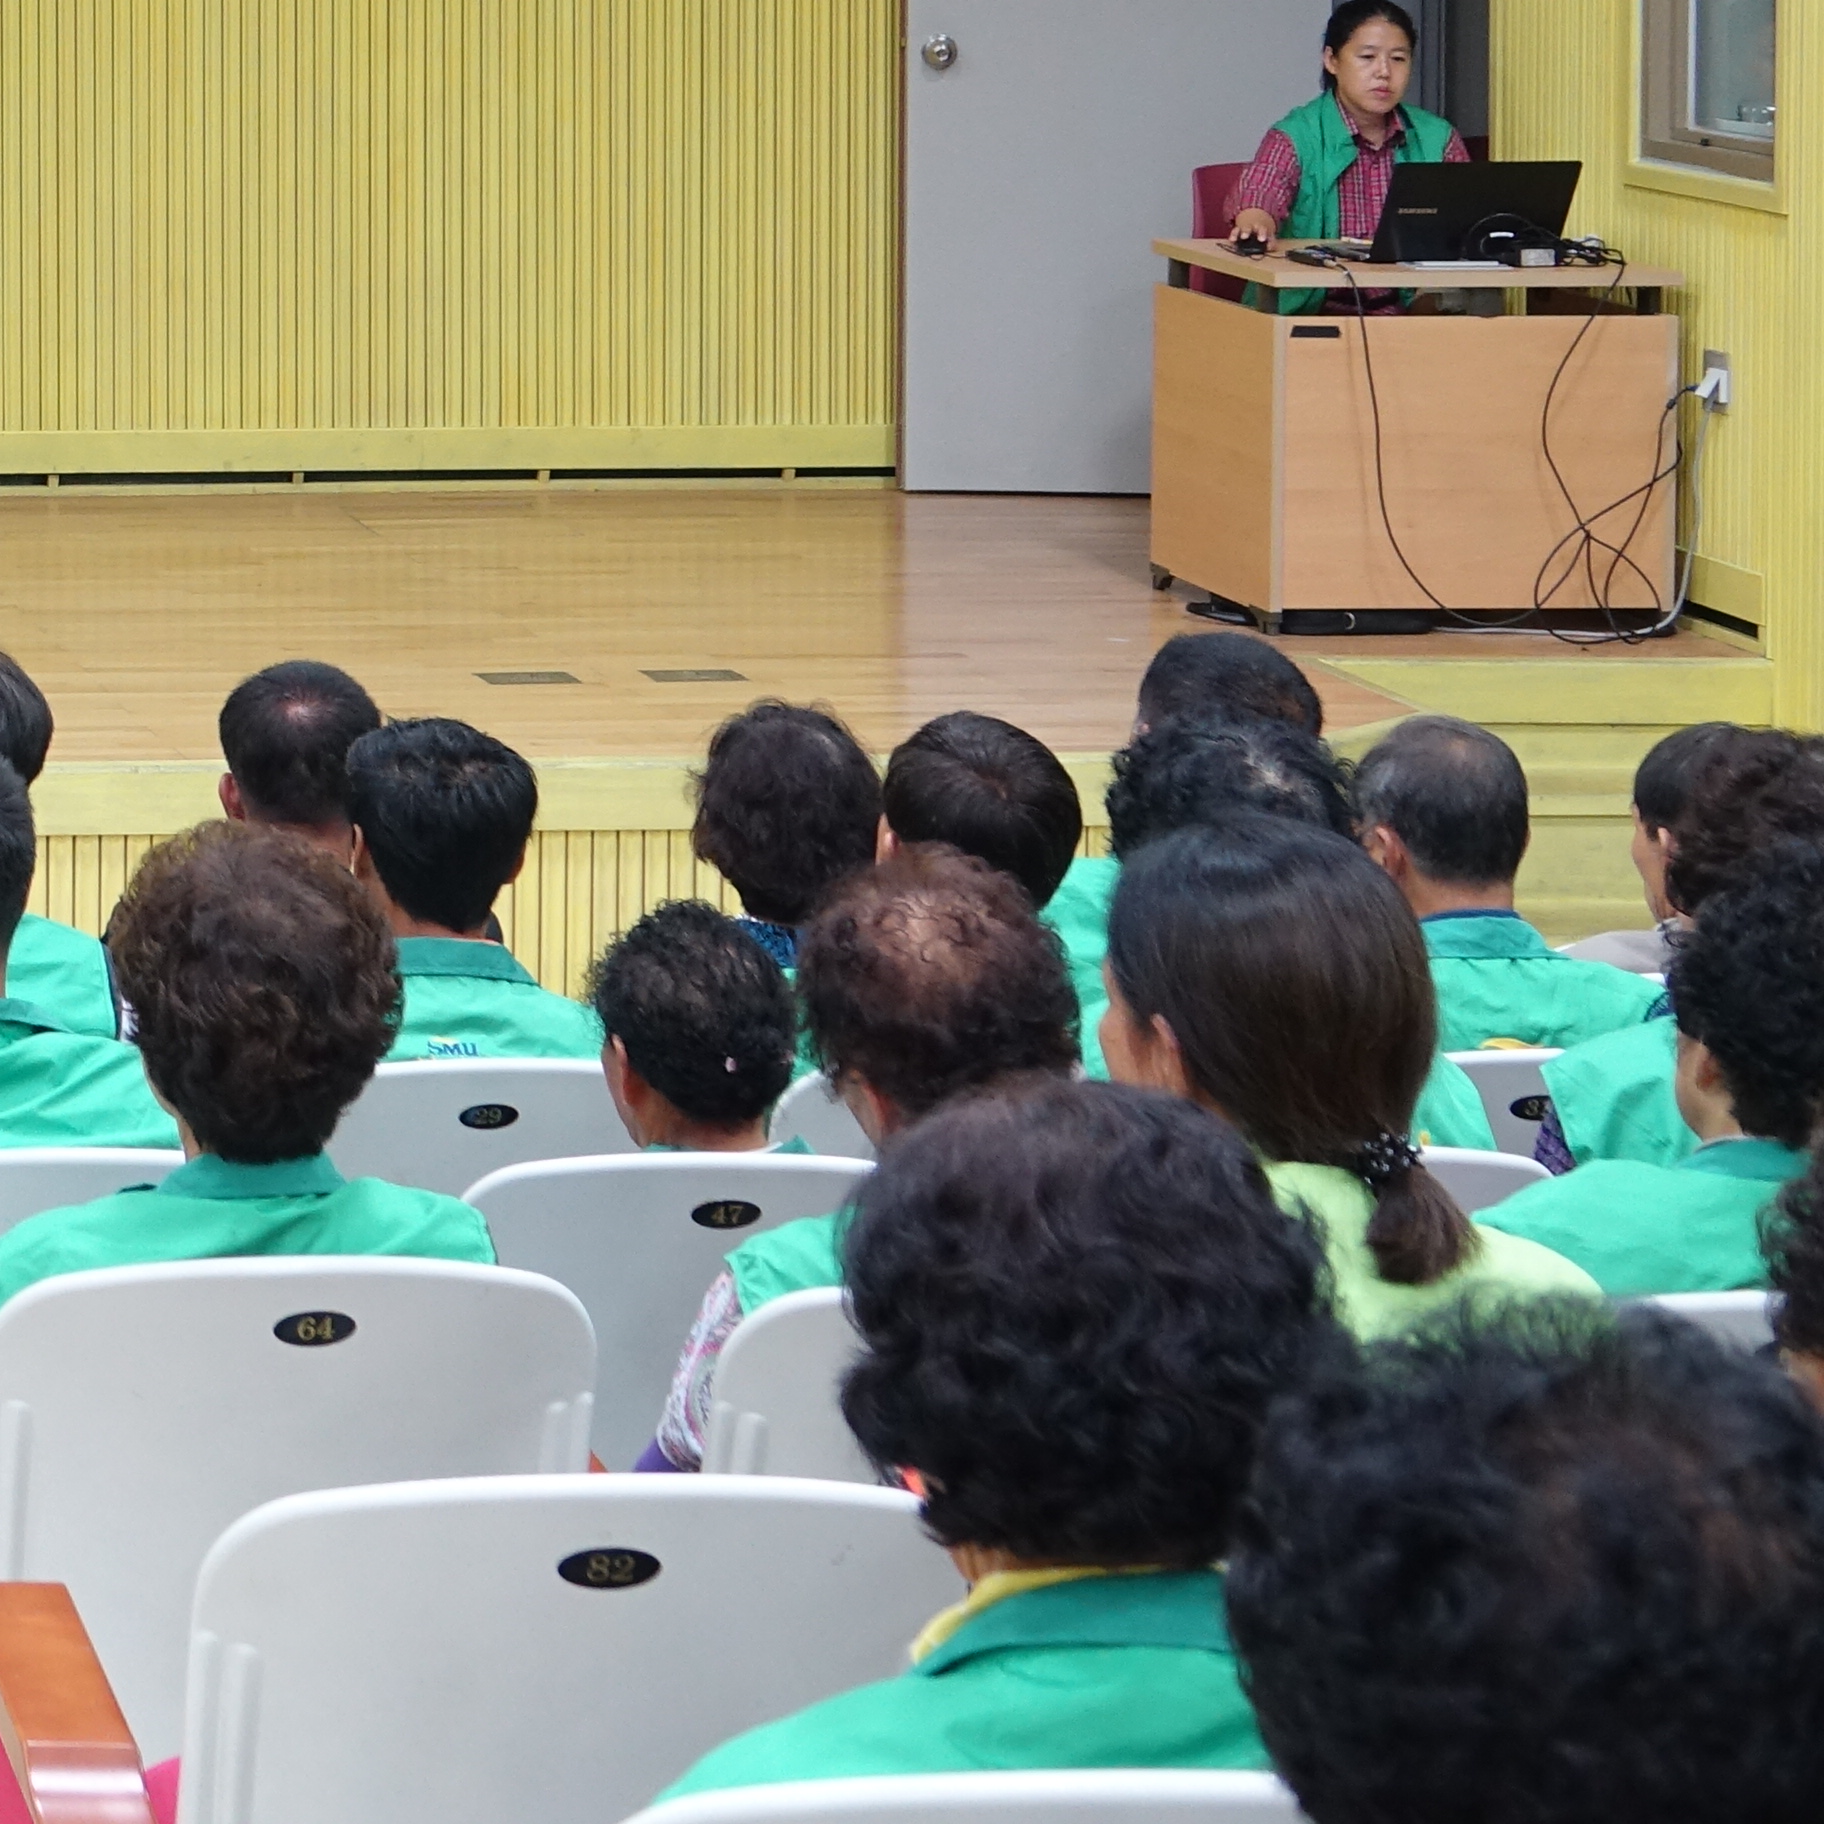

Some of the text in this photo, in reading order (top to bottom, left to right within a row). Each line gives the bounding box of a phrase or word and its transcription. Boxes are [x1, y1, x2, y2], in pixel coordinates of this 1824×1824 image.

[427, 1041, 479, 1057] SMU
[712, 1205, 744, 1224] 47
[296, 1316, 336, 1341] 64
